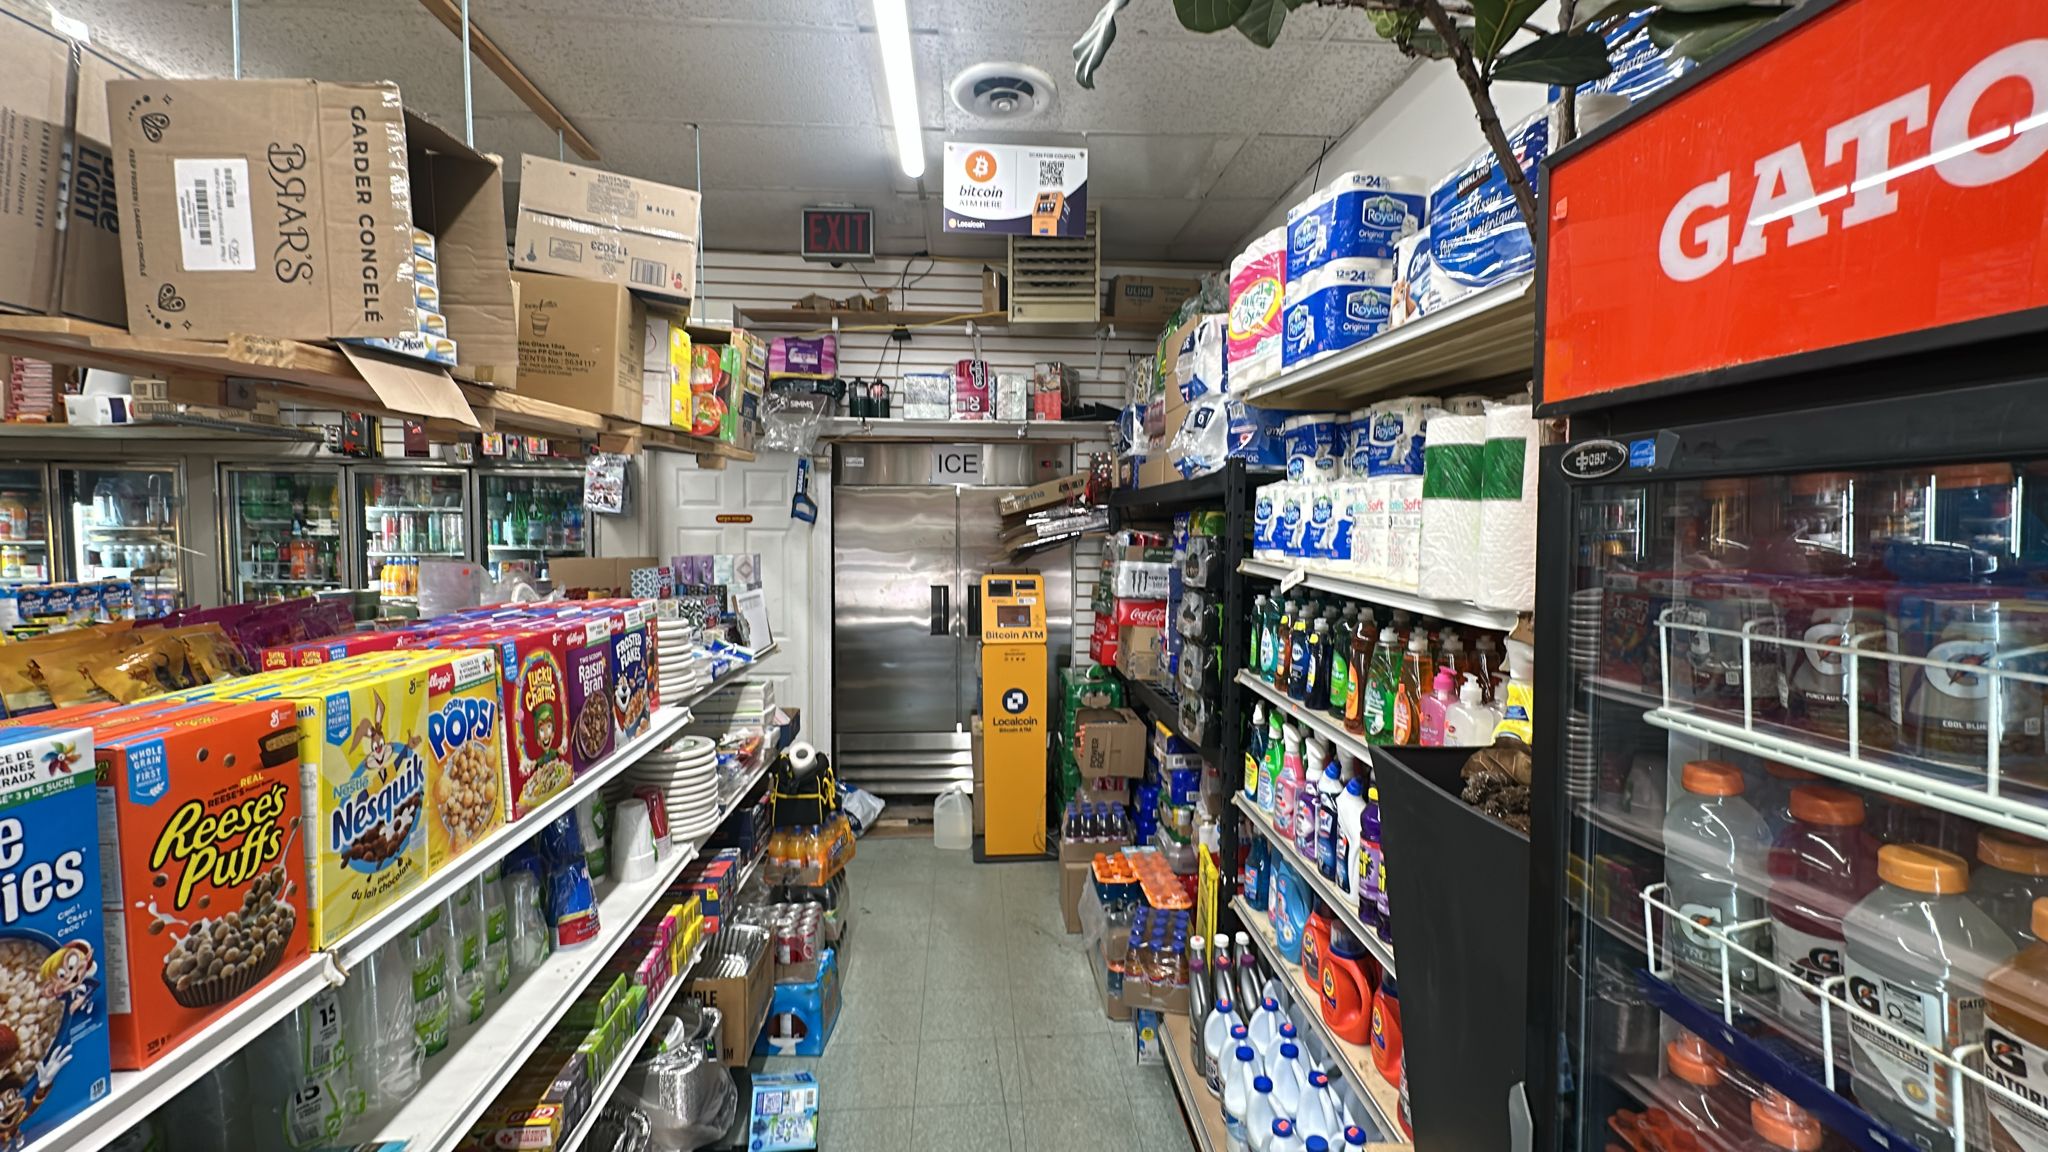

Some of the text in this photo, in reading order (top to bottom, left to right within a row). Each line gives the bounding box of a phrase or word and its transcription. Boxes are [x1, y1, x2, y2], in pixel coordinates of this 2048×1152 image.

[1658, 38, 2048, 283] GATO
[74, 144, 103, 227] LIGHT
[1457, 164, 1491, 195] KIRKLAND
[959, 184, 1003, 199] bitcoin
[350, 105, 384, 323] GARDER CONGELÉ
[959, 200, 1002, 209] ATM HERE
[956, 219, 986, 229] Localcoin
[1367, 206, 1403, 226] Royale
[807, 213, 868, 251] EXIT
[1358, 230, 1385, 239] Original
[1351, 303, 1389, 318] Royale
[1343, 322, 1370, 332] Original
[402, 337, 425, 352] Moon
[1374, 423, 1401, 440] Royale
[938, 453, 978, 474] ICE
[1403, 498, 1423, 512] Soft
[985, 630, 1044, 639] Bitcoin ATM
[615, 632, 642, 659] FROSTED
[620, 647, 642, 671] FLAKES
[527, 666, 553, 692] Lucky
[578, 660, 604, 684] Raisin
[583, 675, 604, 697] Bran
[443, 699, 464, 716] CORN
[525, 683, 556, 712] Charms
[427, 697, 496, 760] POPS!
[992, 717, 1038, 726] Localcoin
[1942, 720, 1989, 731] COOL BLUE
[16, 749, 34, 760] DE
[128, 745, 163, 762] WHOLE
[133, 756, 162, 770] GRAIN
[135, 768, 162, 783] FIRST
[240, 772, 265, 788] REAL
[15, 775, 76, 801] 3 g DE SUCRE
[333, 775, 370, 799] Nestlé
[207, 788, 246, 809] REESE'S
[331, 752, 426, 851] Nesquik
[151, 783, 289, 869] Reese's
[175, 819, 284, 909] Puffs
[2, 849, 85, 923] ies
[351, 857, 414, 900] du lait chocolaté
[377, 870, 391, 884] pour
[424, 974, 439, 990] 20
[319, 1002, 337, 1028] 15
[425, 1028, 440, 1043] 20
[1984, 1027, 2028, 1079] G
